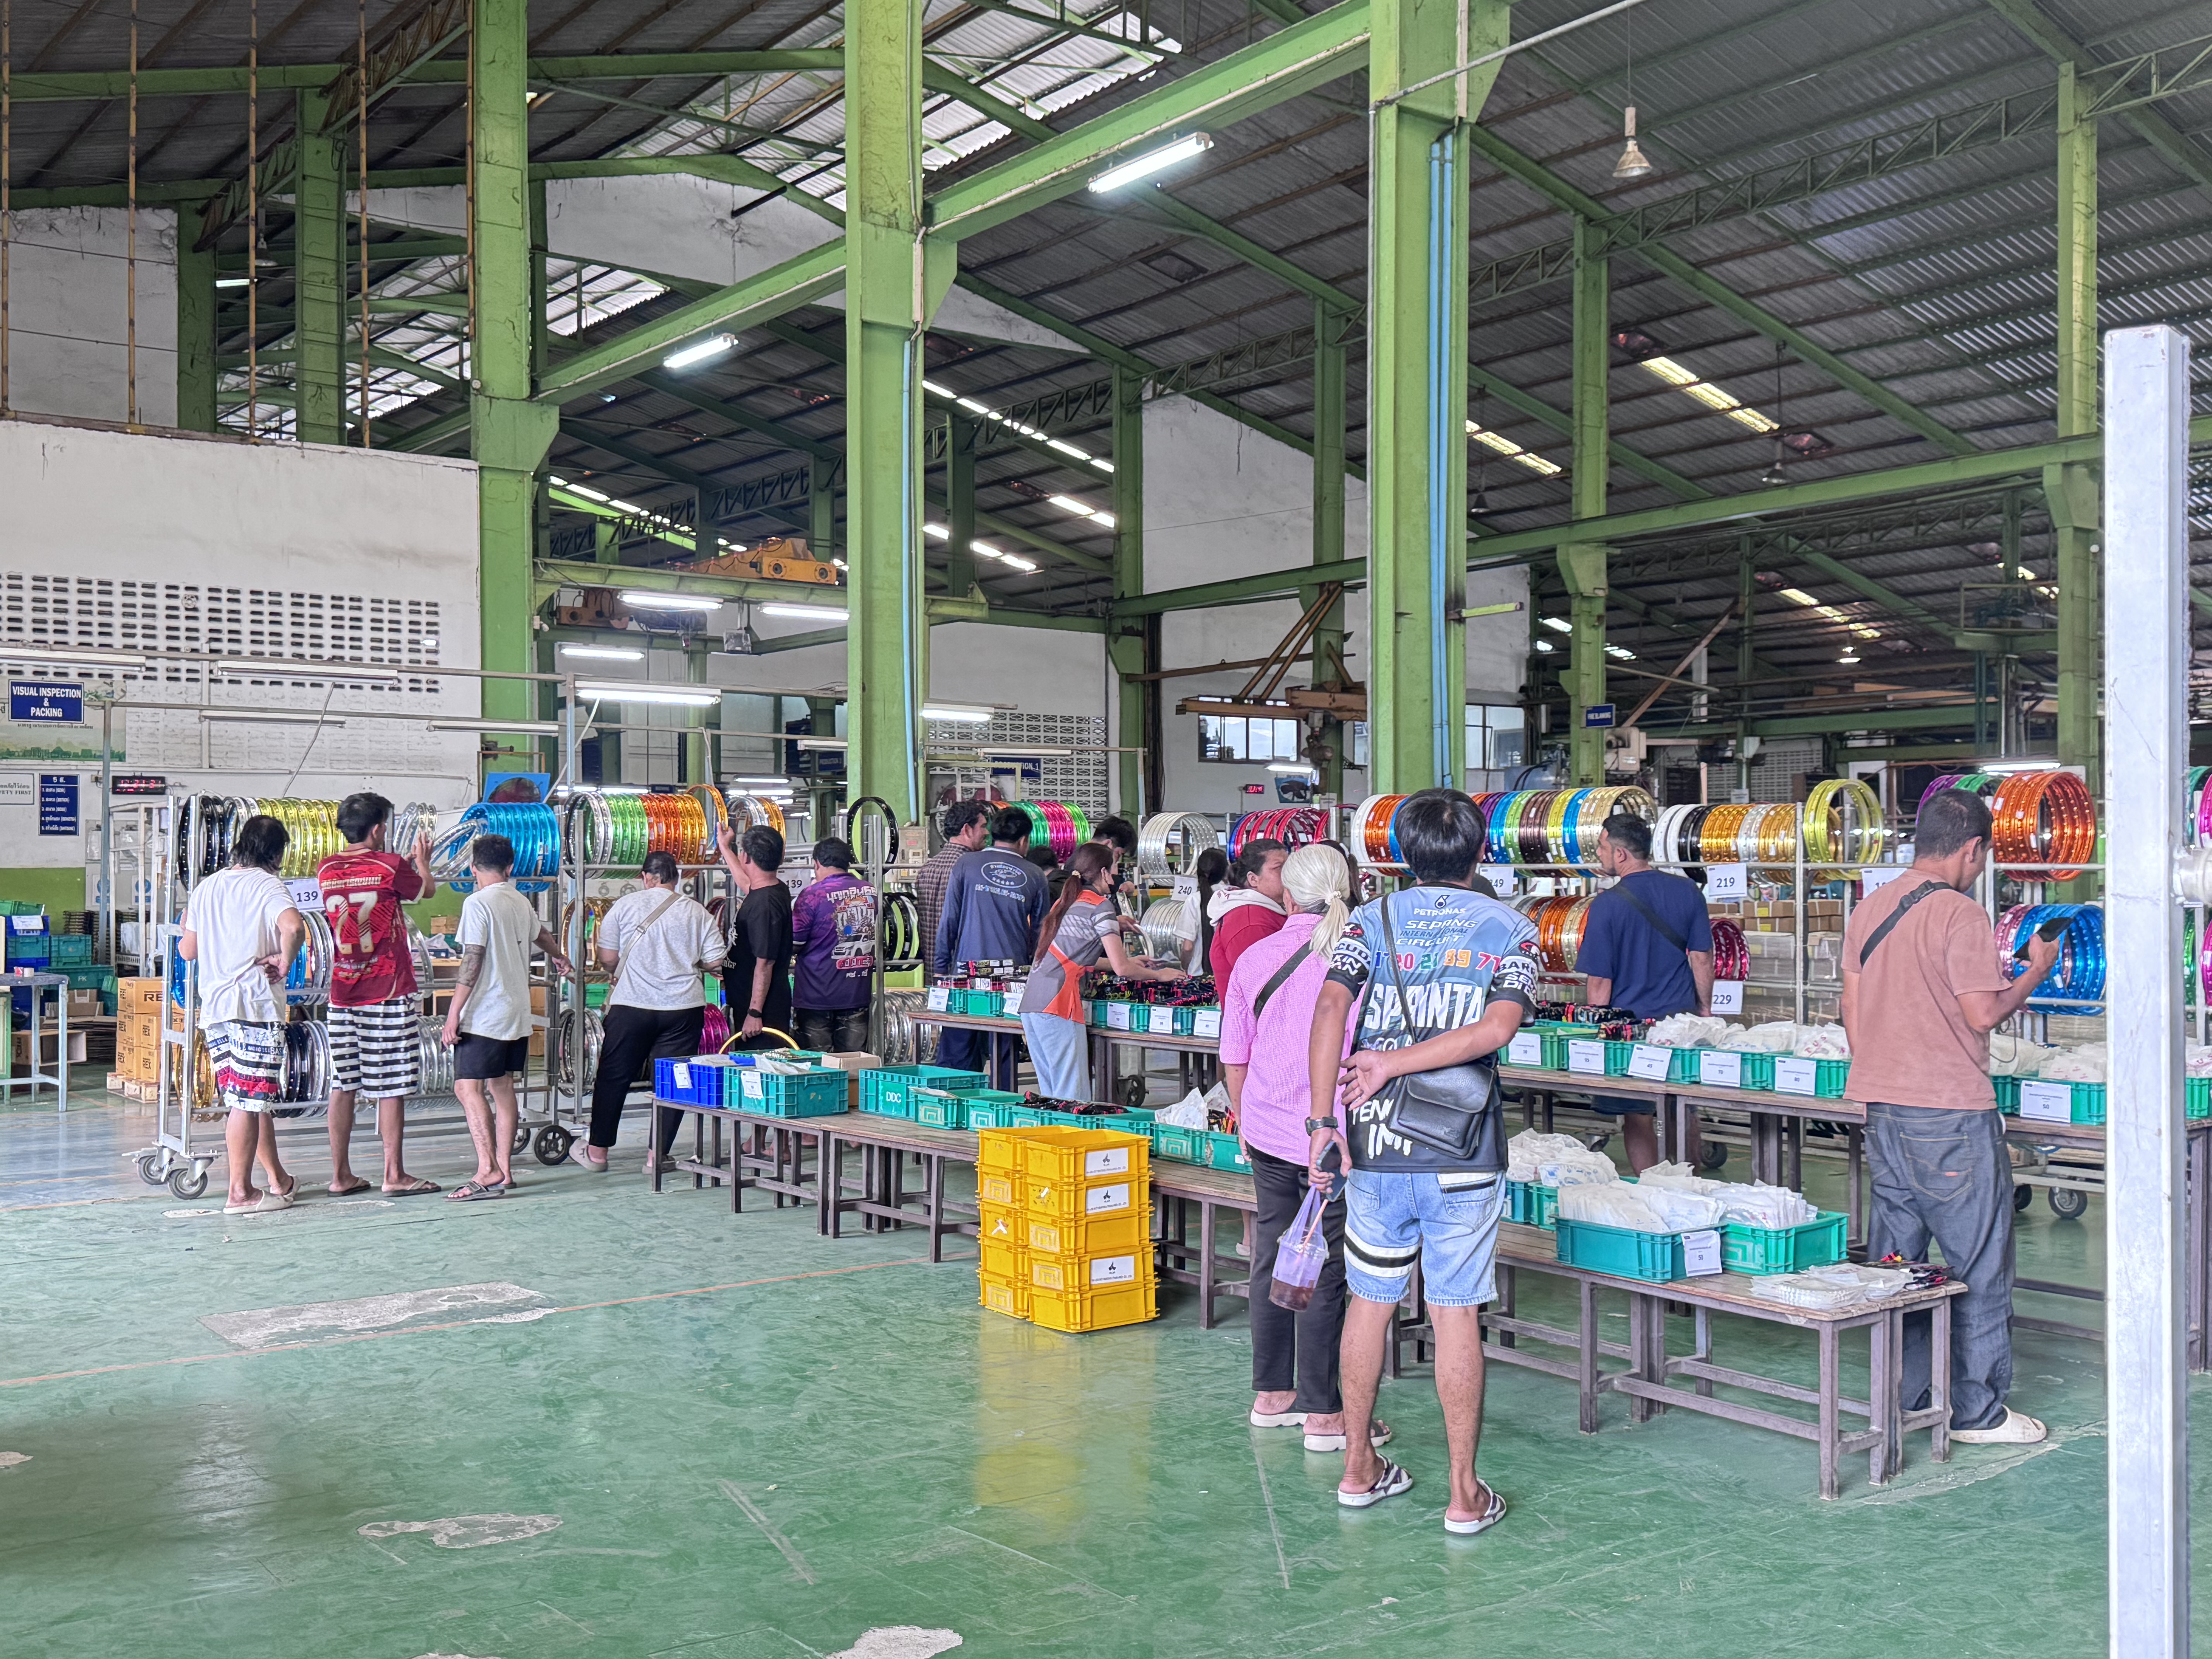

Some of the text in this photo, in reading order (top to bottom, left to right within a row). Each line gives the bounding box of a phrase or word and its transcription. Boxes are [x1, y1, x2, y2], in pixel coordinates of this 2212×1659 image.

[12, 686, 81, 698] VISUAL INSPECTION
[43, 697, 50, 707] &
[31, 707, 63, 717] PACKING
[1716, 877, 1735, 888] 219
[1178, 885, 1192, 895] 240
[297, 891, 318, 902] 139
[1414, 908, 1467, 917] PETRONAS
[326, 891, 378, 955] 27
[1405, 919, 1478, 929] SEPANG
[1443, 949, 1471, 968] 89
[144, 993, 163, 1001] RE
[1712, 994, 1732, 1005] 229
[1364, 982, 1483, 1030] SPRINTA
[142, 1027, 151, 1037] REX
[143, 1060, 151, 1070] REX
[886, 1091, 901, 1103] DDC
